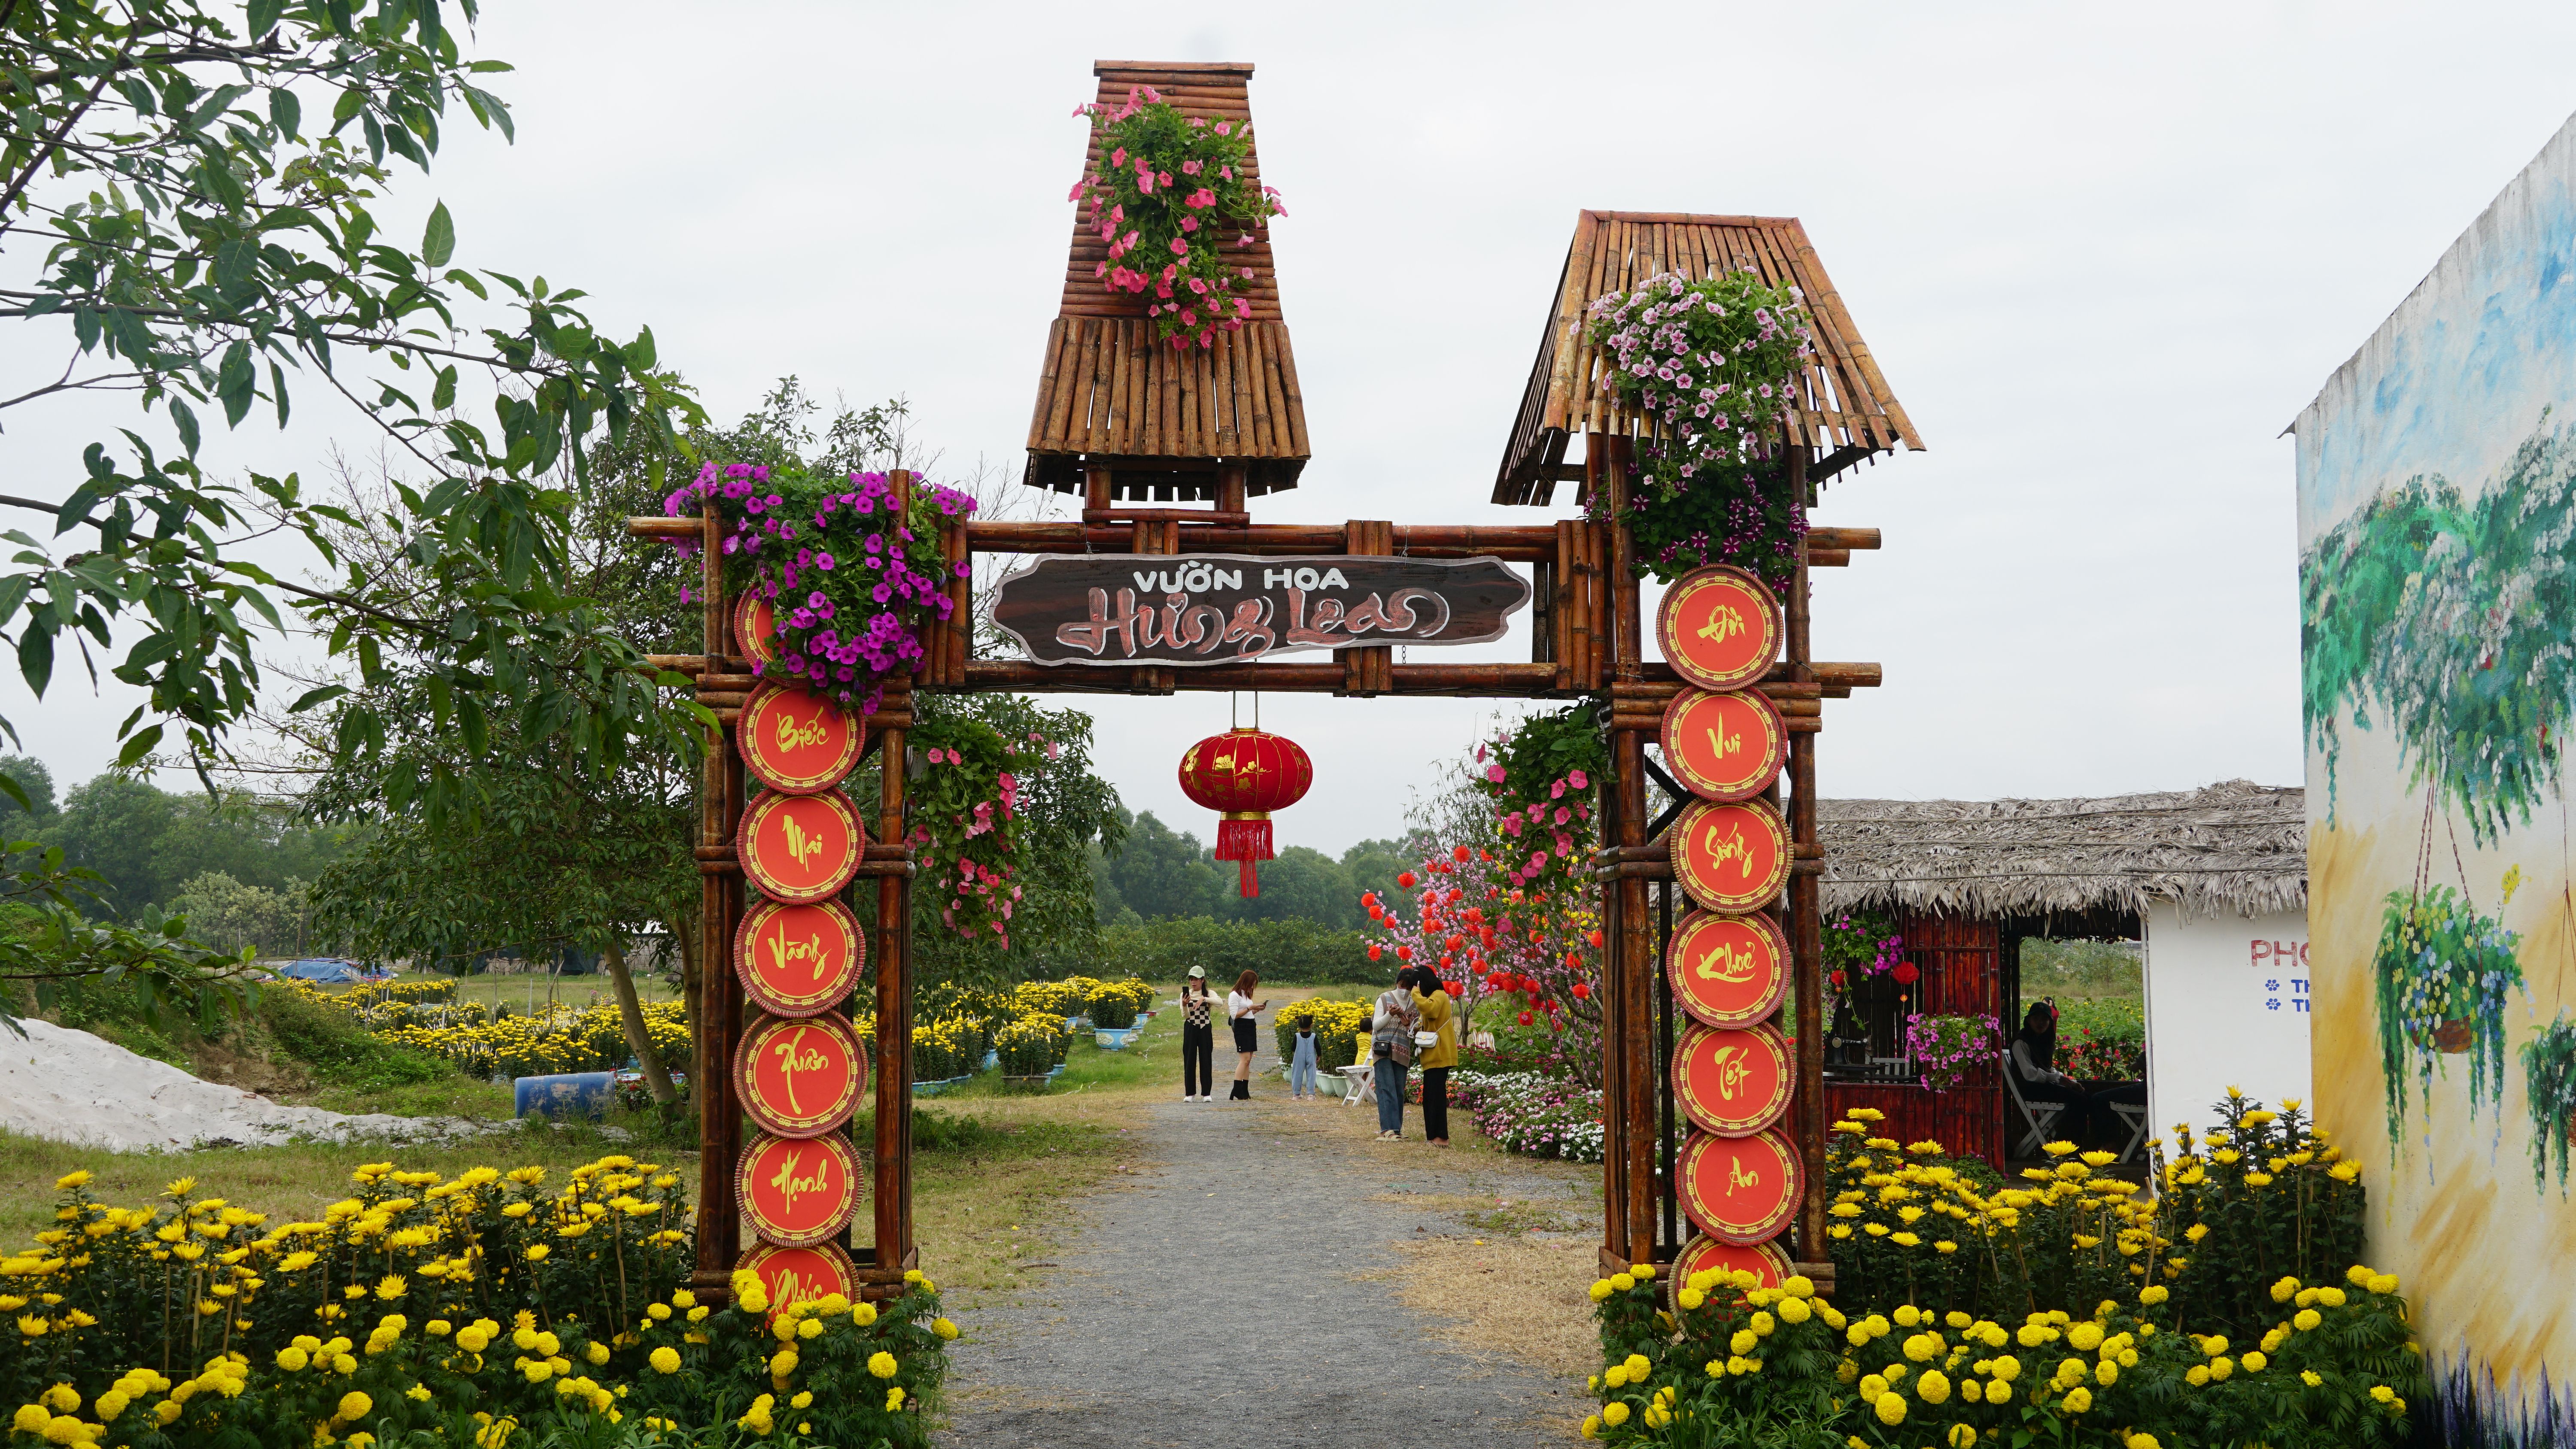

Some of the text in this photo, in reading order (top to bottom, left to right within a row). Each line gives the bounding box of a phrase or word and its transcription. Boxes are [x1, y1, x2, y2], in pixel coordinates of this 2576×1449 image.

[1133, 560, 1349, 594] VƯỜN HOA
[776, 706, 829, 753] Biếc
[1707, 708, 1741, 759] Vui
[782, 815, 822, 873] Mai
[775, 1027, 829, 1115] Xuân
[1714, 1046, 1753, 1100] Tết
[772, 1147, 827, 1215] Hạnh
[1726, 1156, 1759, 1197] An
